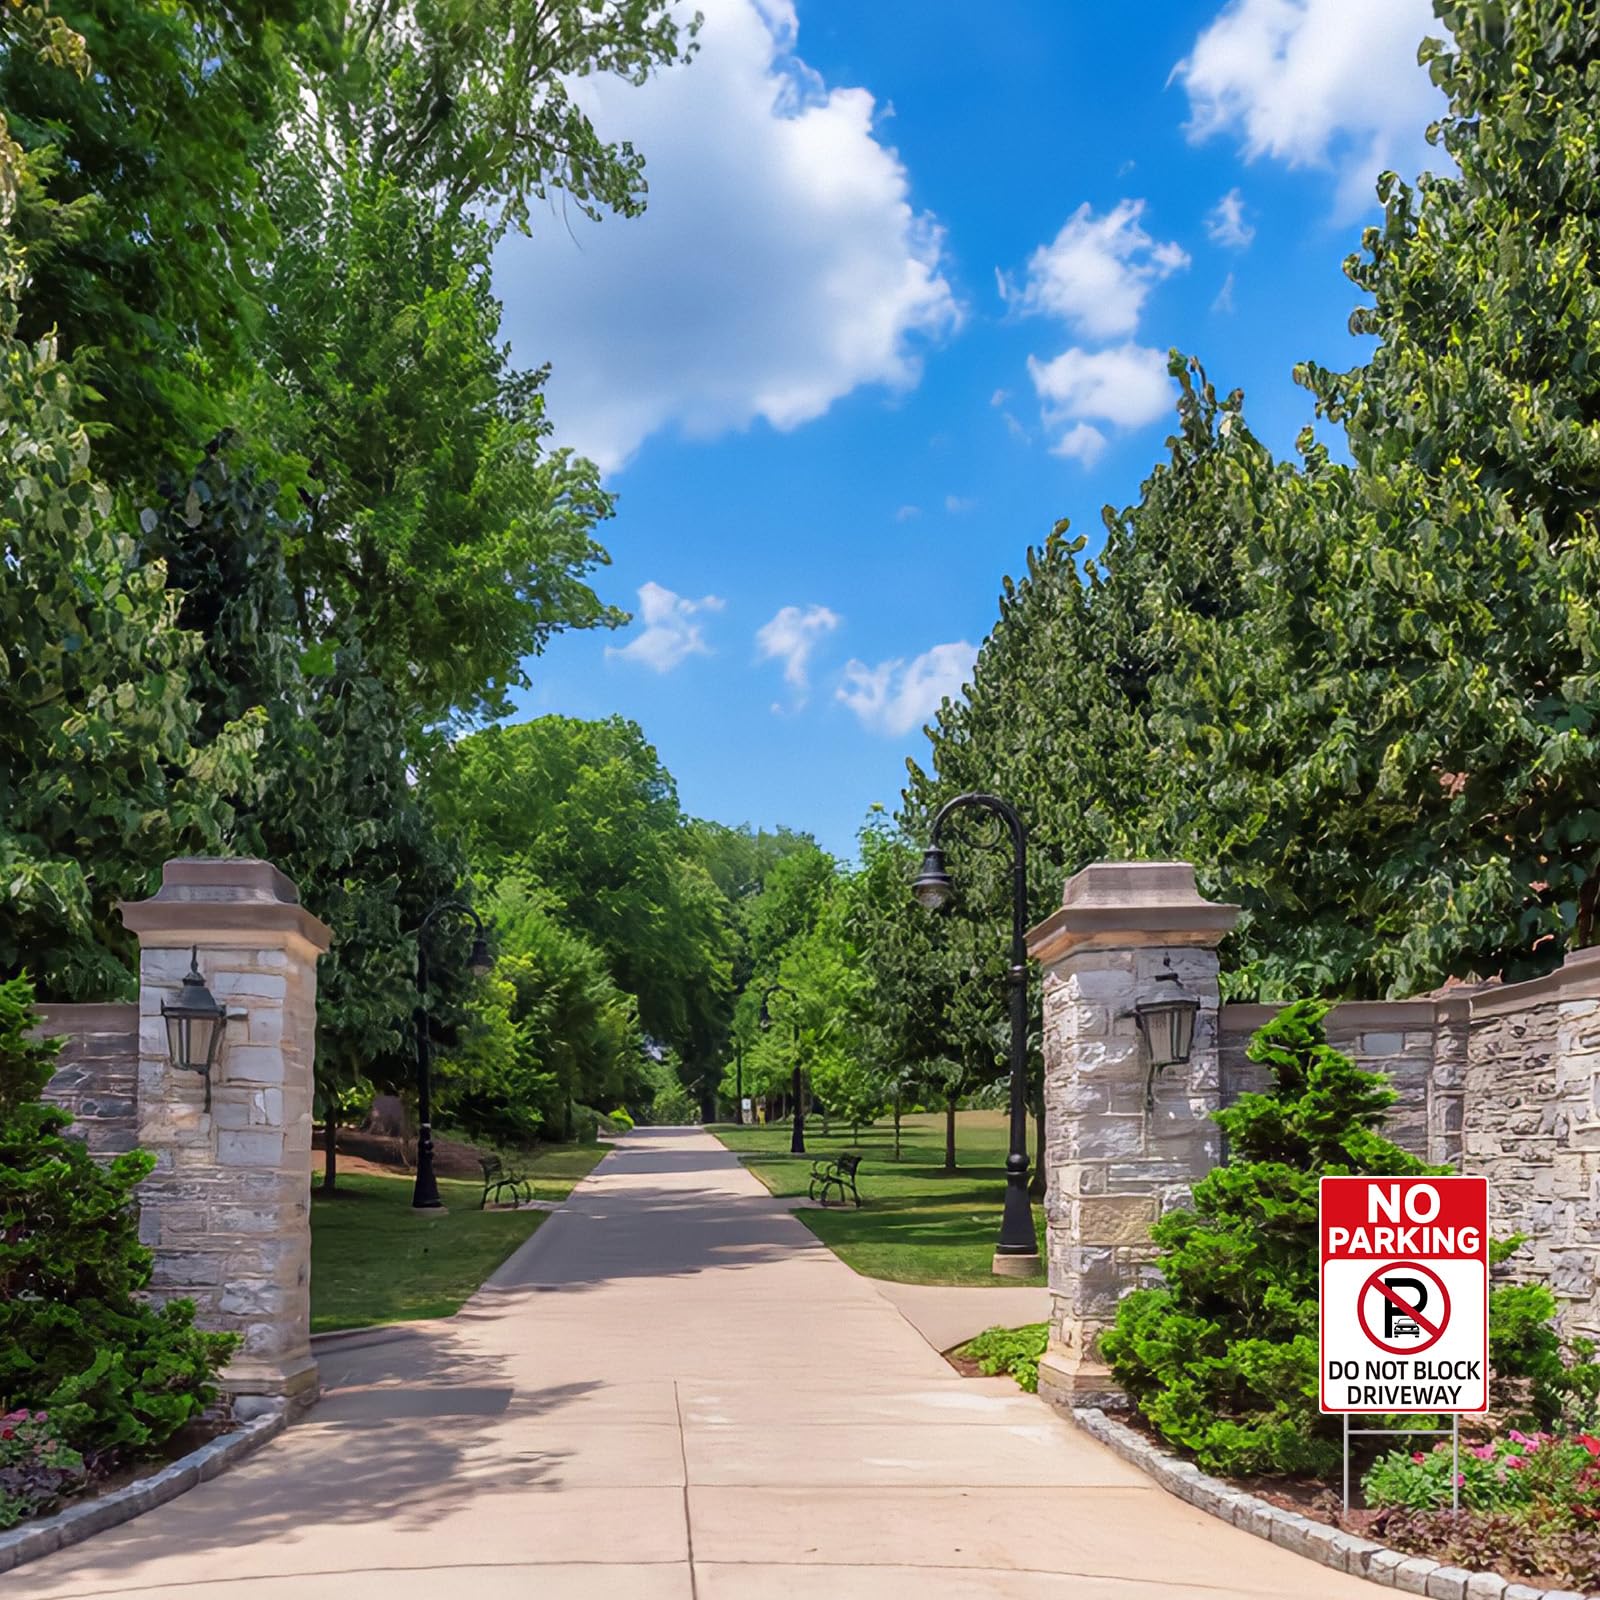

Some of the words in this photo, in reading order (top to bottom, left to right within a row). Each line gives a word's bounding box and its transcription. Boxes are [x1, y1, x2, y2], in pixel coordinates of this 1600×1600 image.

[1367, 1183, 1441, 1224] NO
[1328, 1226, 1480, 1254] PARKING
[1384, 1277, 1428, 1338] P
[1328, 1360, 1360, 1380] DO
[1365, 1360, 1409, 1380] NOT
[1414, 1360, 1481, 1380] BLOCK
[1347, 1385, 1463, 1405] DRIVEWAY
